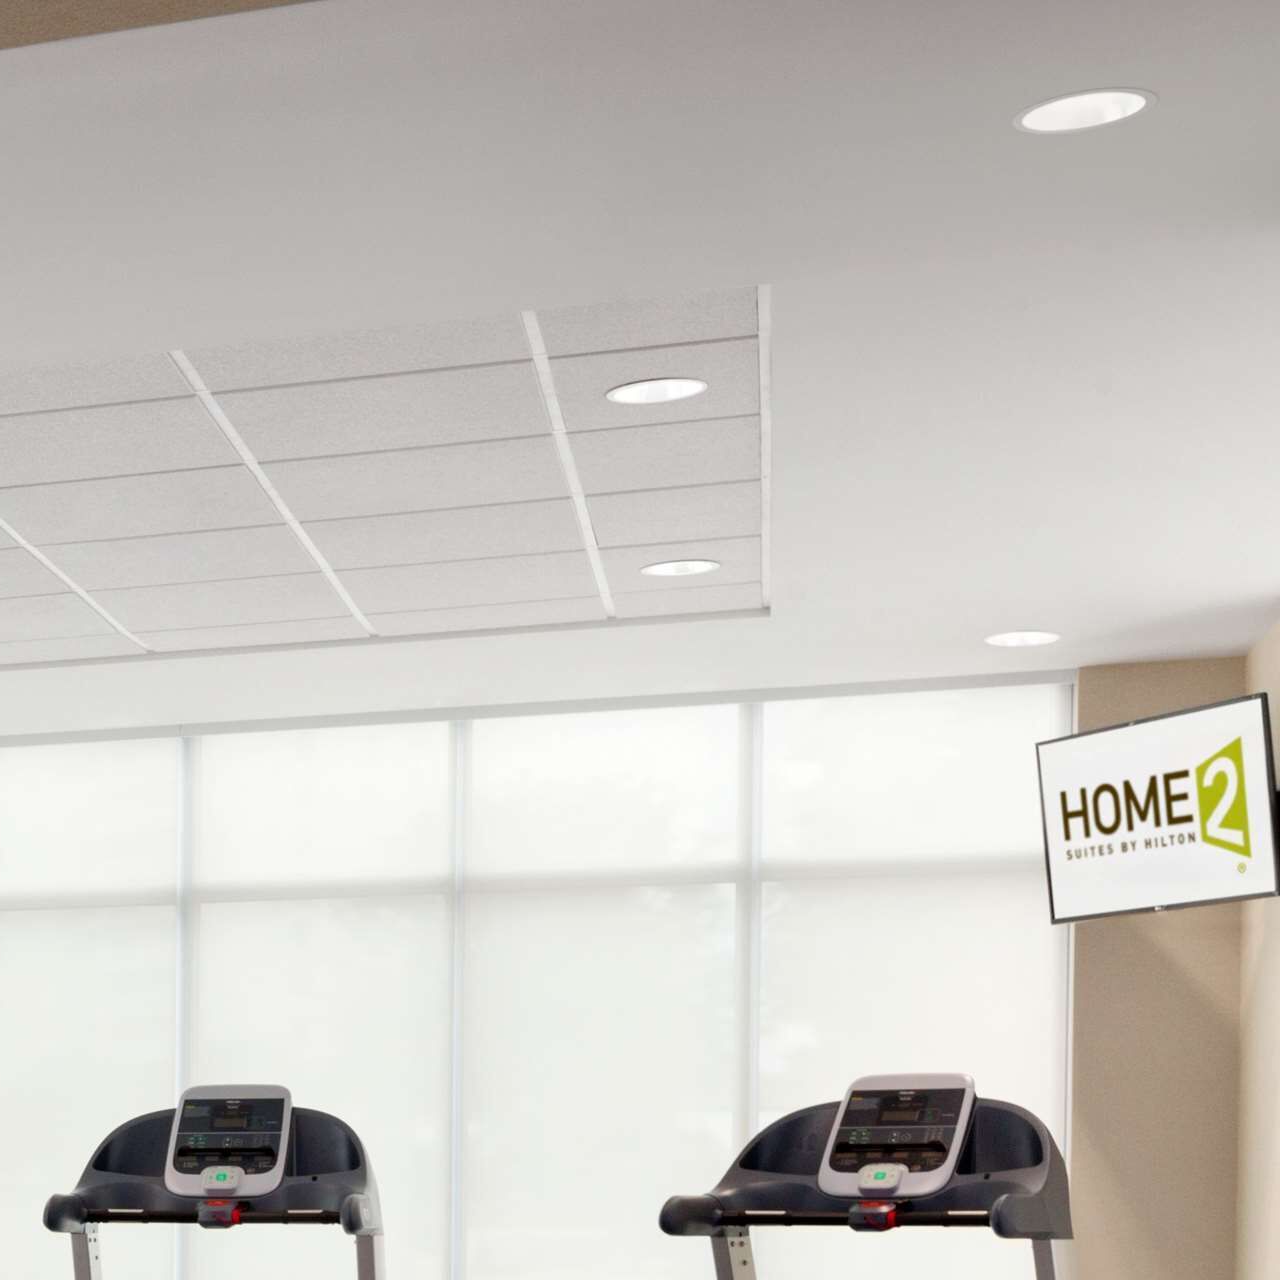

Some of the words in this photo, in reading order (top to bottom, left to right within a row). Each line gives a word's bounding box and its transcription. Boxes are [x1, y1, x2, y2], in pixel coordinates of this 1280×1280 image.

[1066, 844, 1115, 861] SUITES
[1121, 840, 1137, 853] BY
[1144, 832, 1197, 850] HILTON
